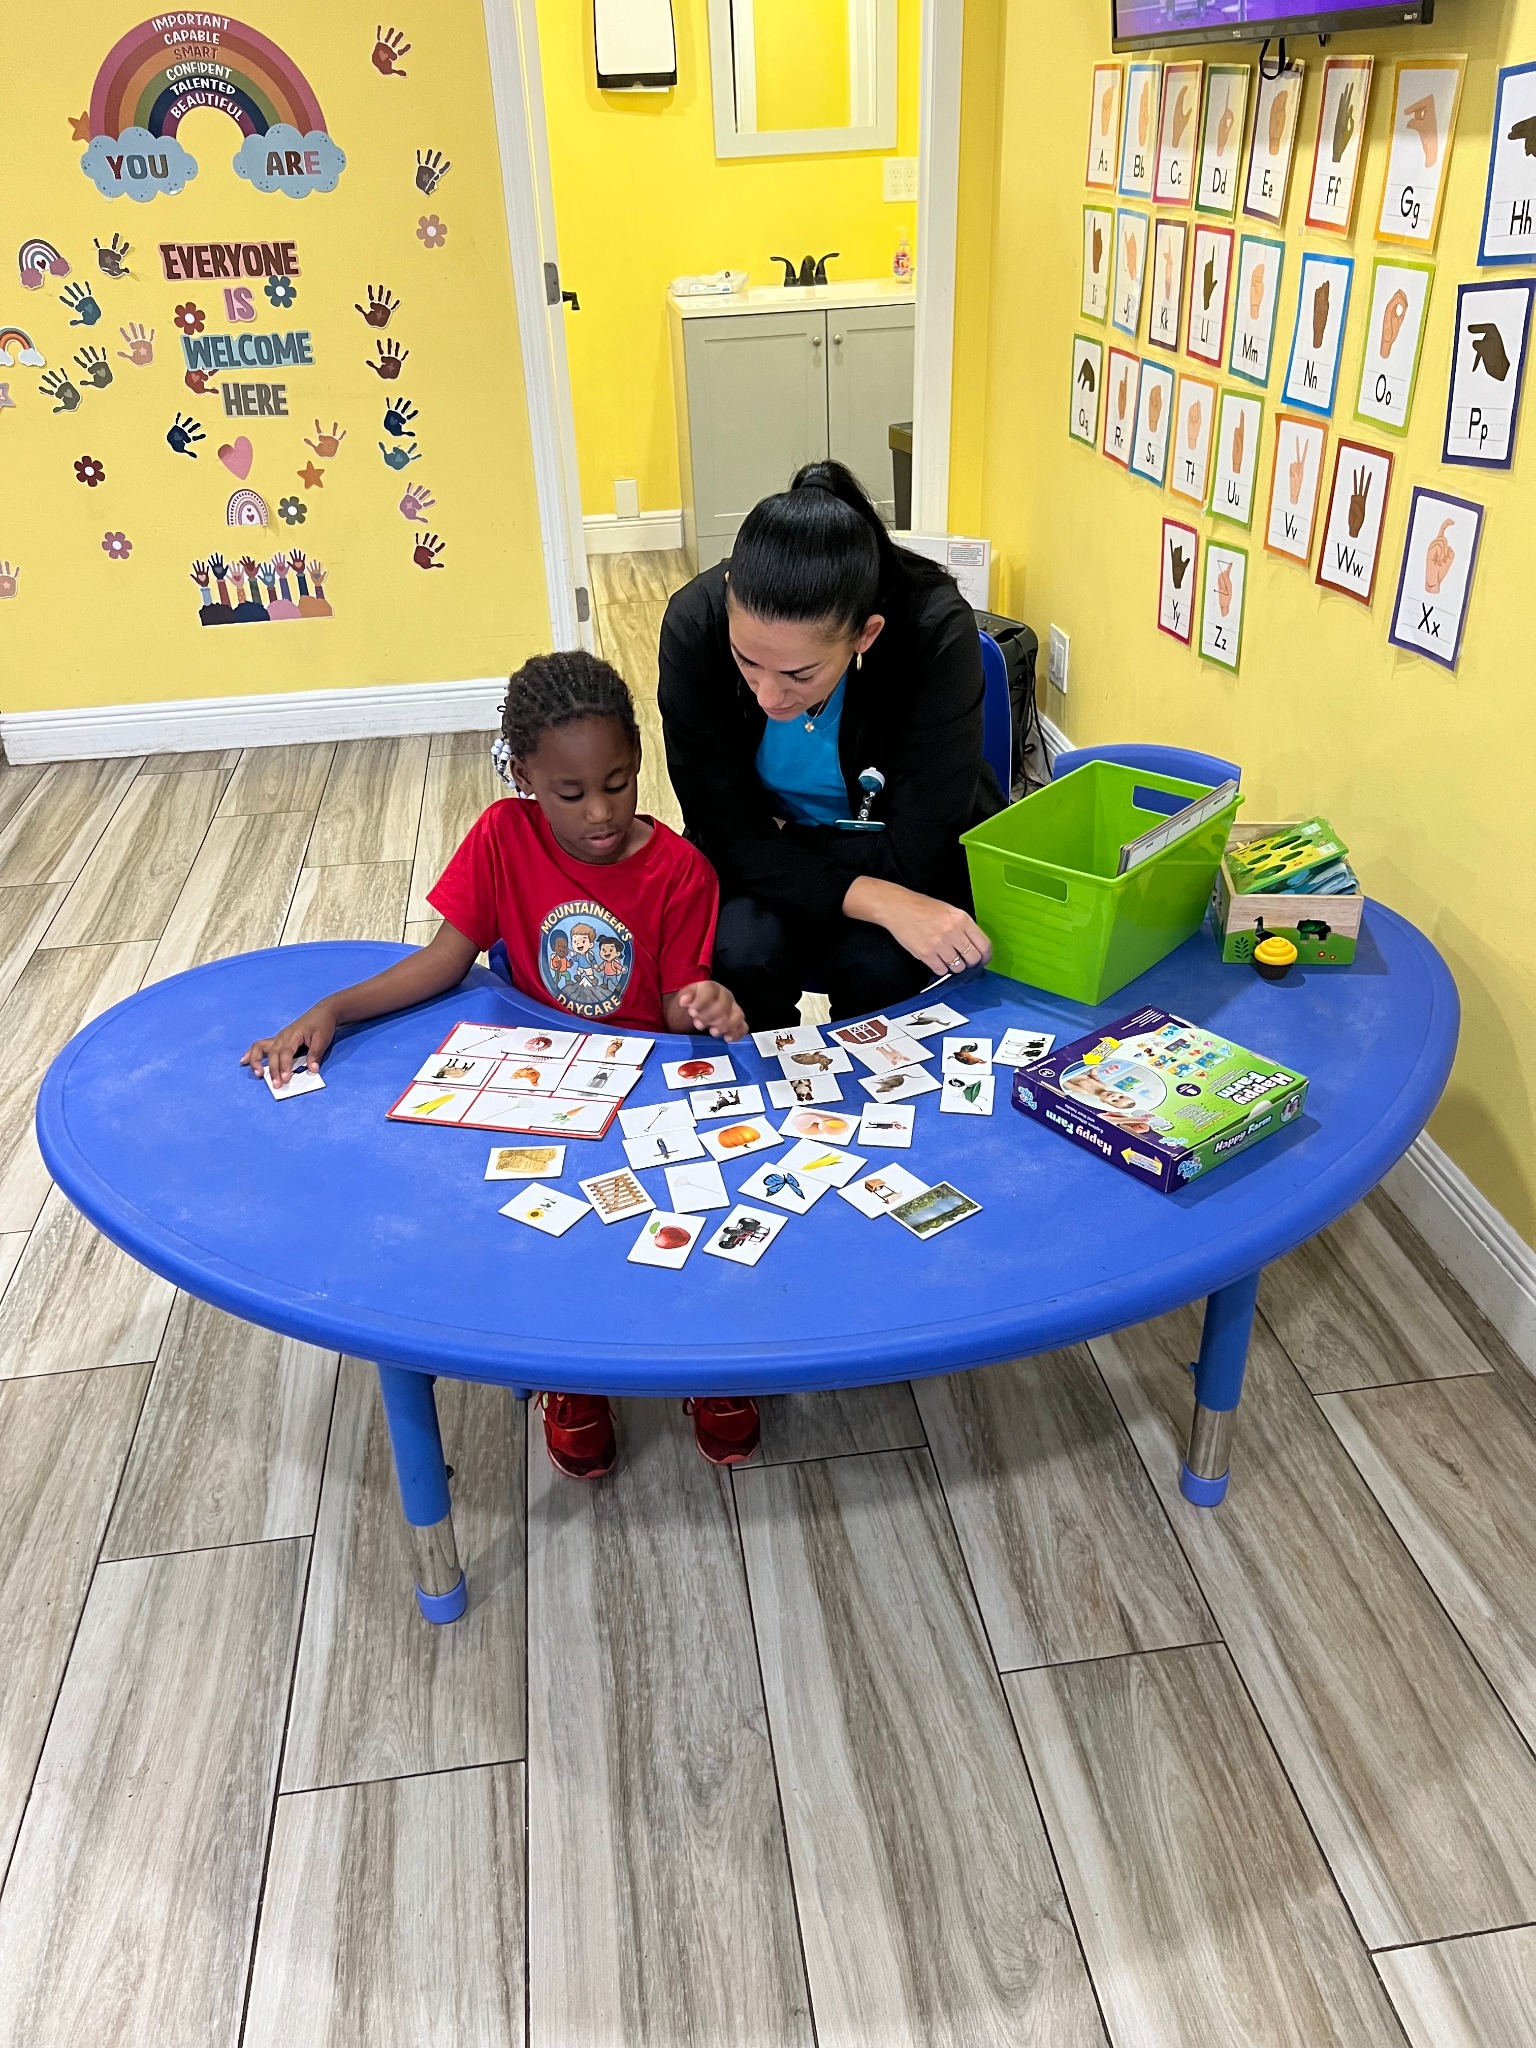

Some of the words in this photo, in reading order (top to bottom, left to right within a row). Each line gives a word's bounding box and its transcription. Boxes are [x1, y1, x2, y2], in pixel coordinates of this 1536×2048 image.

[152, 13, 230, 31] IMPORTANT
[164, 30, 220, 45] CAPABLE
[174, 46, 218, 60] SMART
[166, 62, 232, 81] CONFIDENT
[169, 77, 235, 96] TALENTED
[170, 92, 243, 122] BEAUTIFUL
[105, 153, 169, 180] YOU
[266, 150, 322, 177] ARE
[1097, 149, 1108, 172] Aa
[1134, 154, 1145, 178] Bb
[1170, 160, 1182, 185] Cc
[1212, 167, 1228, 195] Dd
[1261, 168, 1273, 198] Ee
[1325, 175, 1342, 206] Ff
[1401, 185, 1421, 230] Gg
[1509, 198, 1533, 236] Hh
[160, 242, 299, 280] EVERYONE
[224, 287, 255, 321] IS
[1160, 306, 1169, 331] Kk
[1200, 318, 1210, 344] Ll
[182, 332, 313, 370] WELCOME
[1242, 331, 1259, 364] Mm
[1303, 359, 1319, 390] Nn
[222, 383, 289, 416] HERE
[1375, 373, 1393, 406] Oo
[1078, 408, 1089, 437] Qq
[1114, 425, 1124, 448] Rr
[1468, 407, 1490, 450] Pp
[1145, 442, 1155, 465] Ss
[1185, 459, 1195, 485] Tt
[1227, 479, 1241, 507] Uu
[1285, 512, 1299, 541] Vv
[1337, 542, 1365, 579] Ww
[1172, 599, 1181, 630] Yy
[1417, 602, 1441, 639] Xx
[1214, 625, 1228, 652] Zz
[541, 902, 632, 942] MOUNTAINEER'S
[556, 993, 621, 1017] DAYCARE
[1215, 1071, 1267, 1099] Farm
[1232, 1072, 1295, 1105] Happy
[1046, 1109, 1074, 1135] Farm
[1214, 1130, 1247, 1153] Happy
[1247, 1115, 1272, 1135] Farm
[1076, 1126, 1113, 1156] Happy
